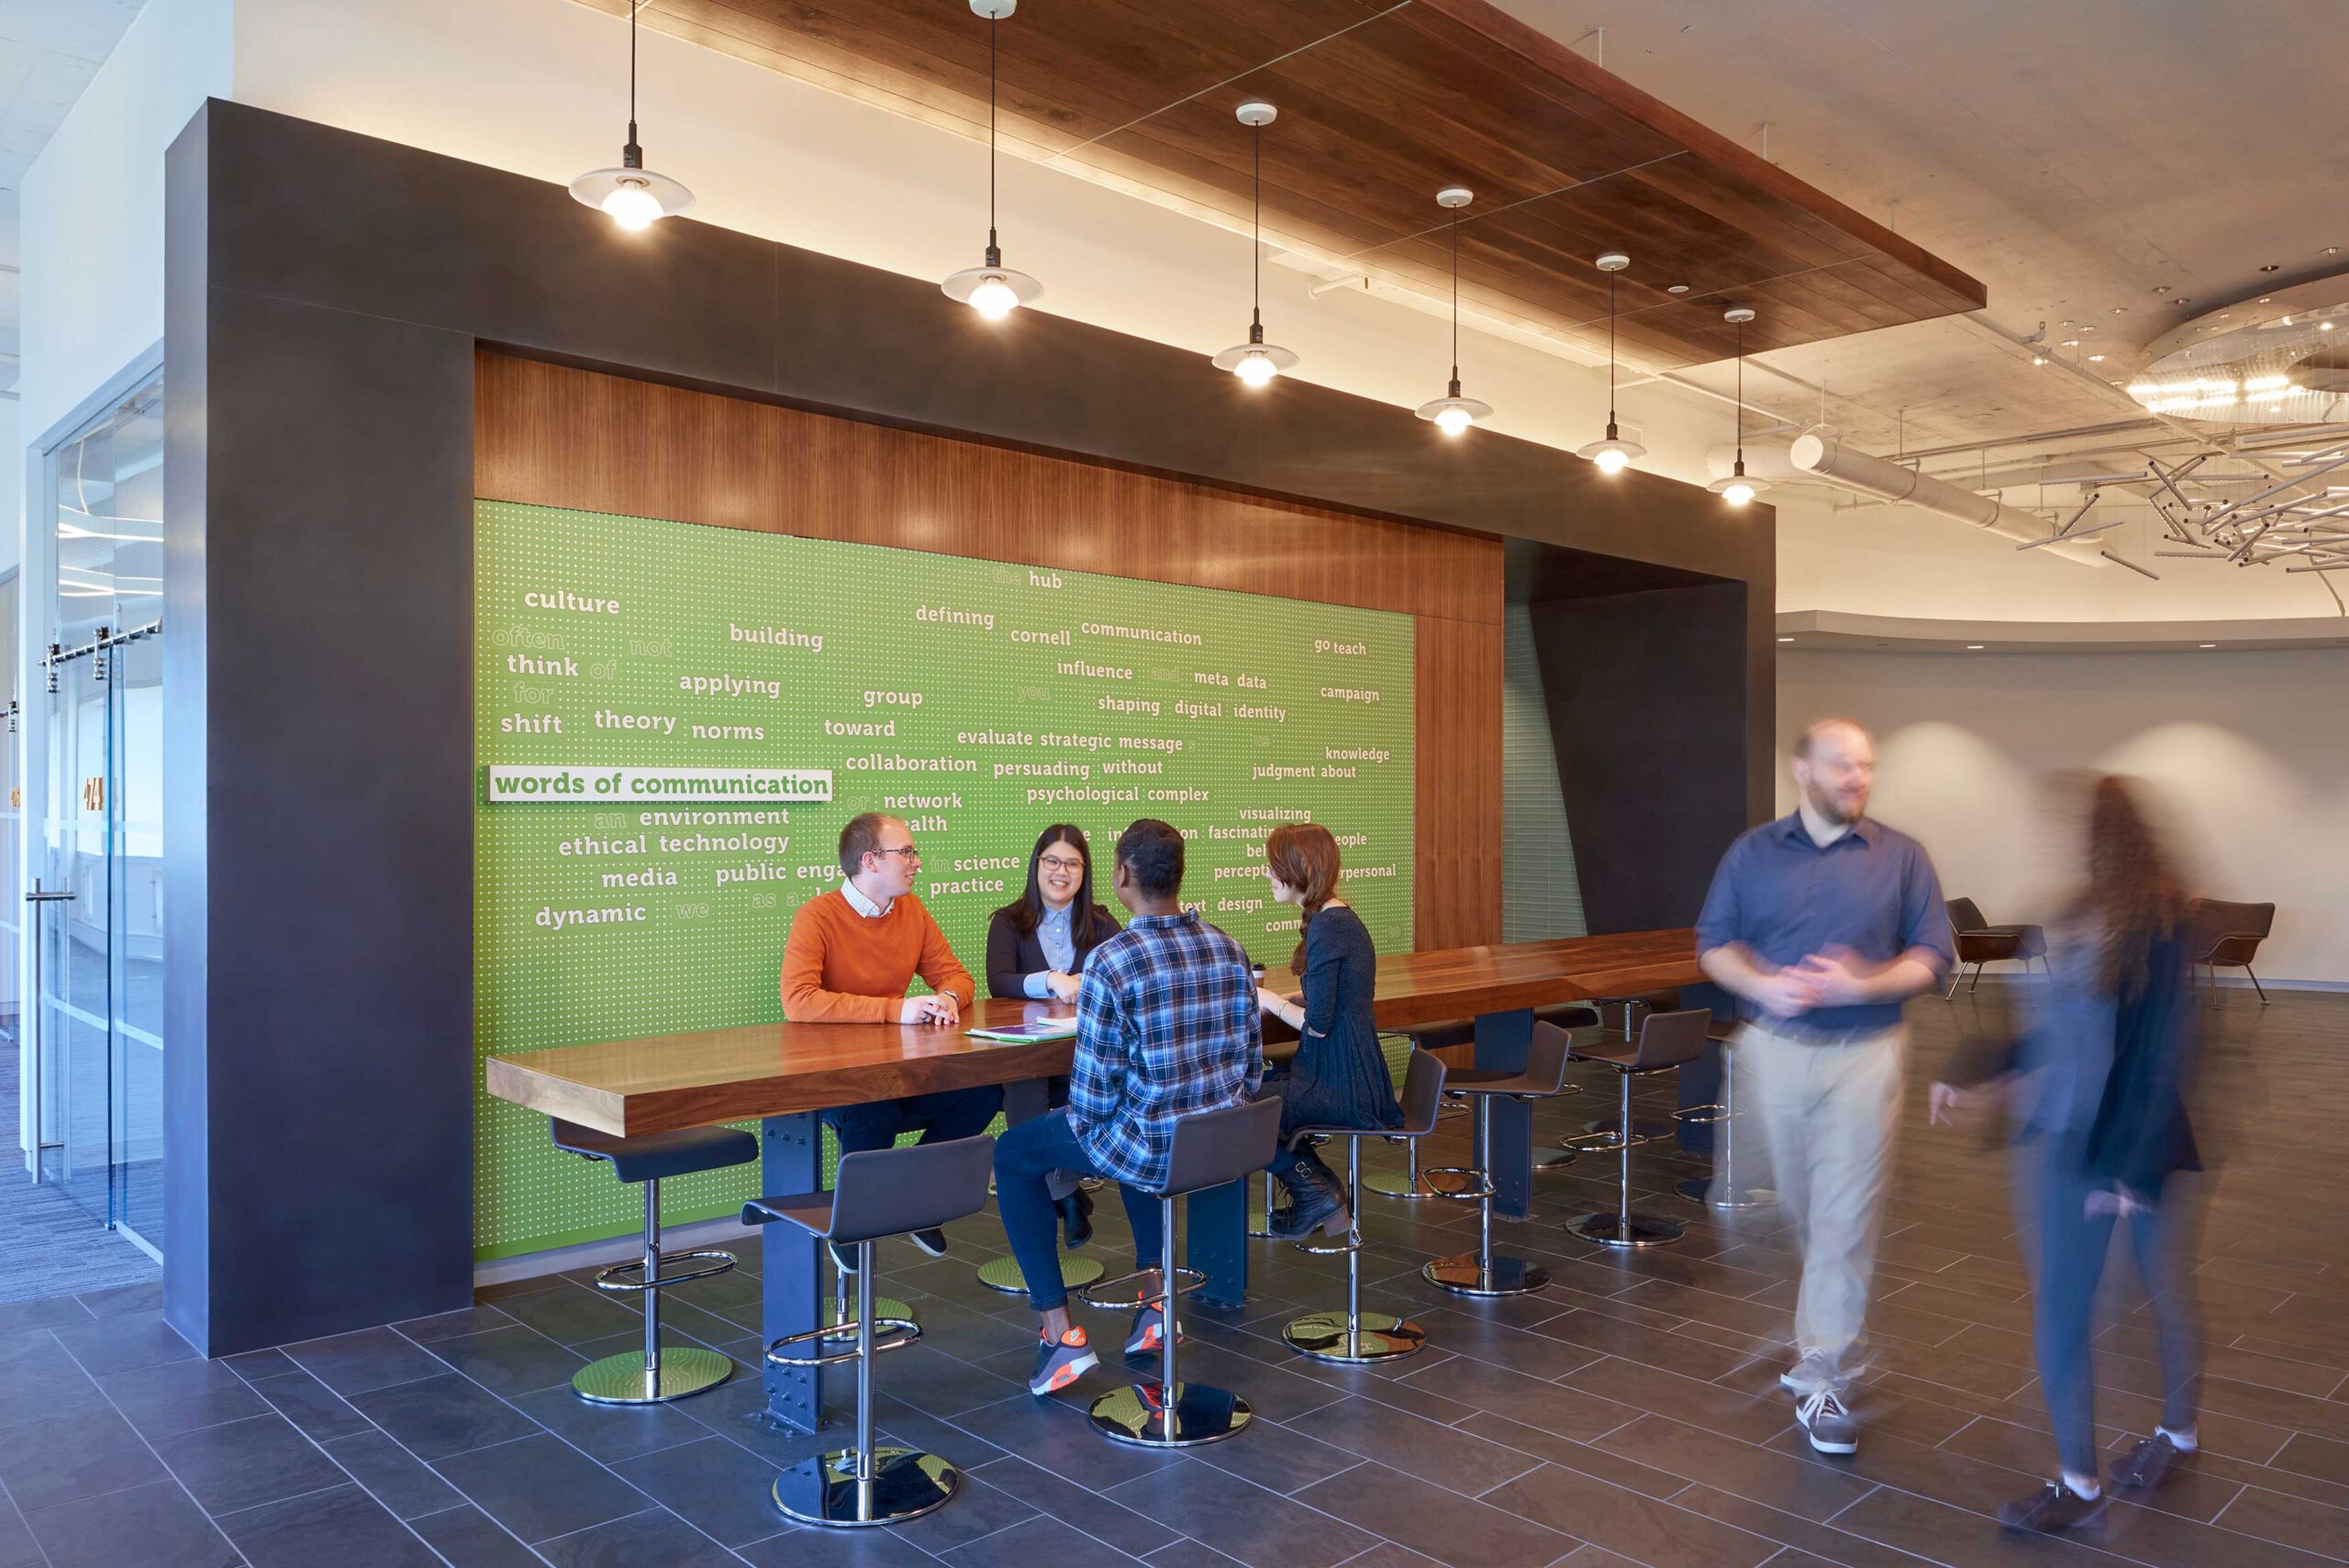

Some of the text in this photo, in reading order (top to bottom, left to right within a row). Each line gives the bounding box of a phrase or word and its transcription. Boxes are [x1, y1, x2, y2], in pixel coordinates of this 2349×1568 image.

[1030, 571, 1062, 589] hub
[524, 590, 620, 615] culture
[916, 604, 995, 630] defining
[492, 626, 565, 650] often
[729, 622, 824, 653] building
[1011, 628, 1071, 647] cornell
[1082, 621, 1202, 646] communication
[629, 639, 673, 657] not
[1314, 639, 1366, 656] go teach
[507, 653, 617, 680] think of
[1057, 659, 1133, 680] influence
[1194, 672, 1230, 687] meta
[1237, 673, 1267, 690] data
[514, 682, 554, 704] for
[679, 673, 782, 699] applying
[1320, 686, 1379, 704] campaign
[863, 690, 923, 709] group
[1098, 695, 1286, 723] shaping digital identity
[500, 709, 765, 741] shift theory norms
[824, 719, 896, 738] toward
[957, 728, 1033, 745] evaluate
[1041, 731, 1112, 751] strategic
[1119, 736, 1183, 753] message
[1325, 747, 1390, 762] knowledge
[846, 753, 1163, 780] collaboration persuading without
[1252, 763, 1356, 780] judgment about
[495, 772, 829, 795] words of communication
[884, 792, 963, 809] network
[1027, 785, 1209, 805] psychological complex
[595, 806, 790, 828] an environment
[1240, 806, 1311, 823] visualizing
[1208, 825, 1274, 840] fascinati
[1335, 832, 1367, 848] eople
[558, 832, 790, 856] ethical technology
[715, 862, 787, 886] public
[930, 856, 950, 873] in
[953, 855, 1020, 872] science
[1340, 863, 1397, 881] rpersonal
[601, 867, 678, 888] media
[930, 877, 1004, 899] practice
[751, 891, 776, 908] as
[786, 891, 799, 906] a
[1218, 896, 1263, 913] design
[535, 902, 709, 931] dynamic we
